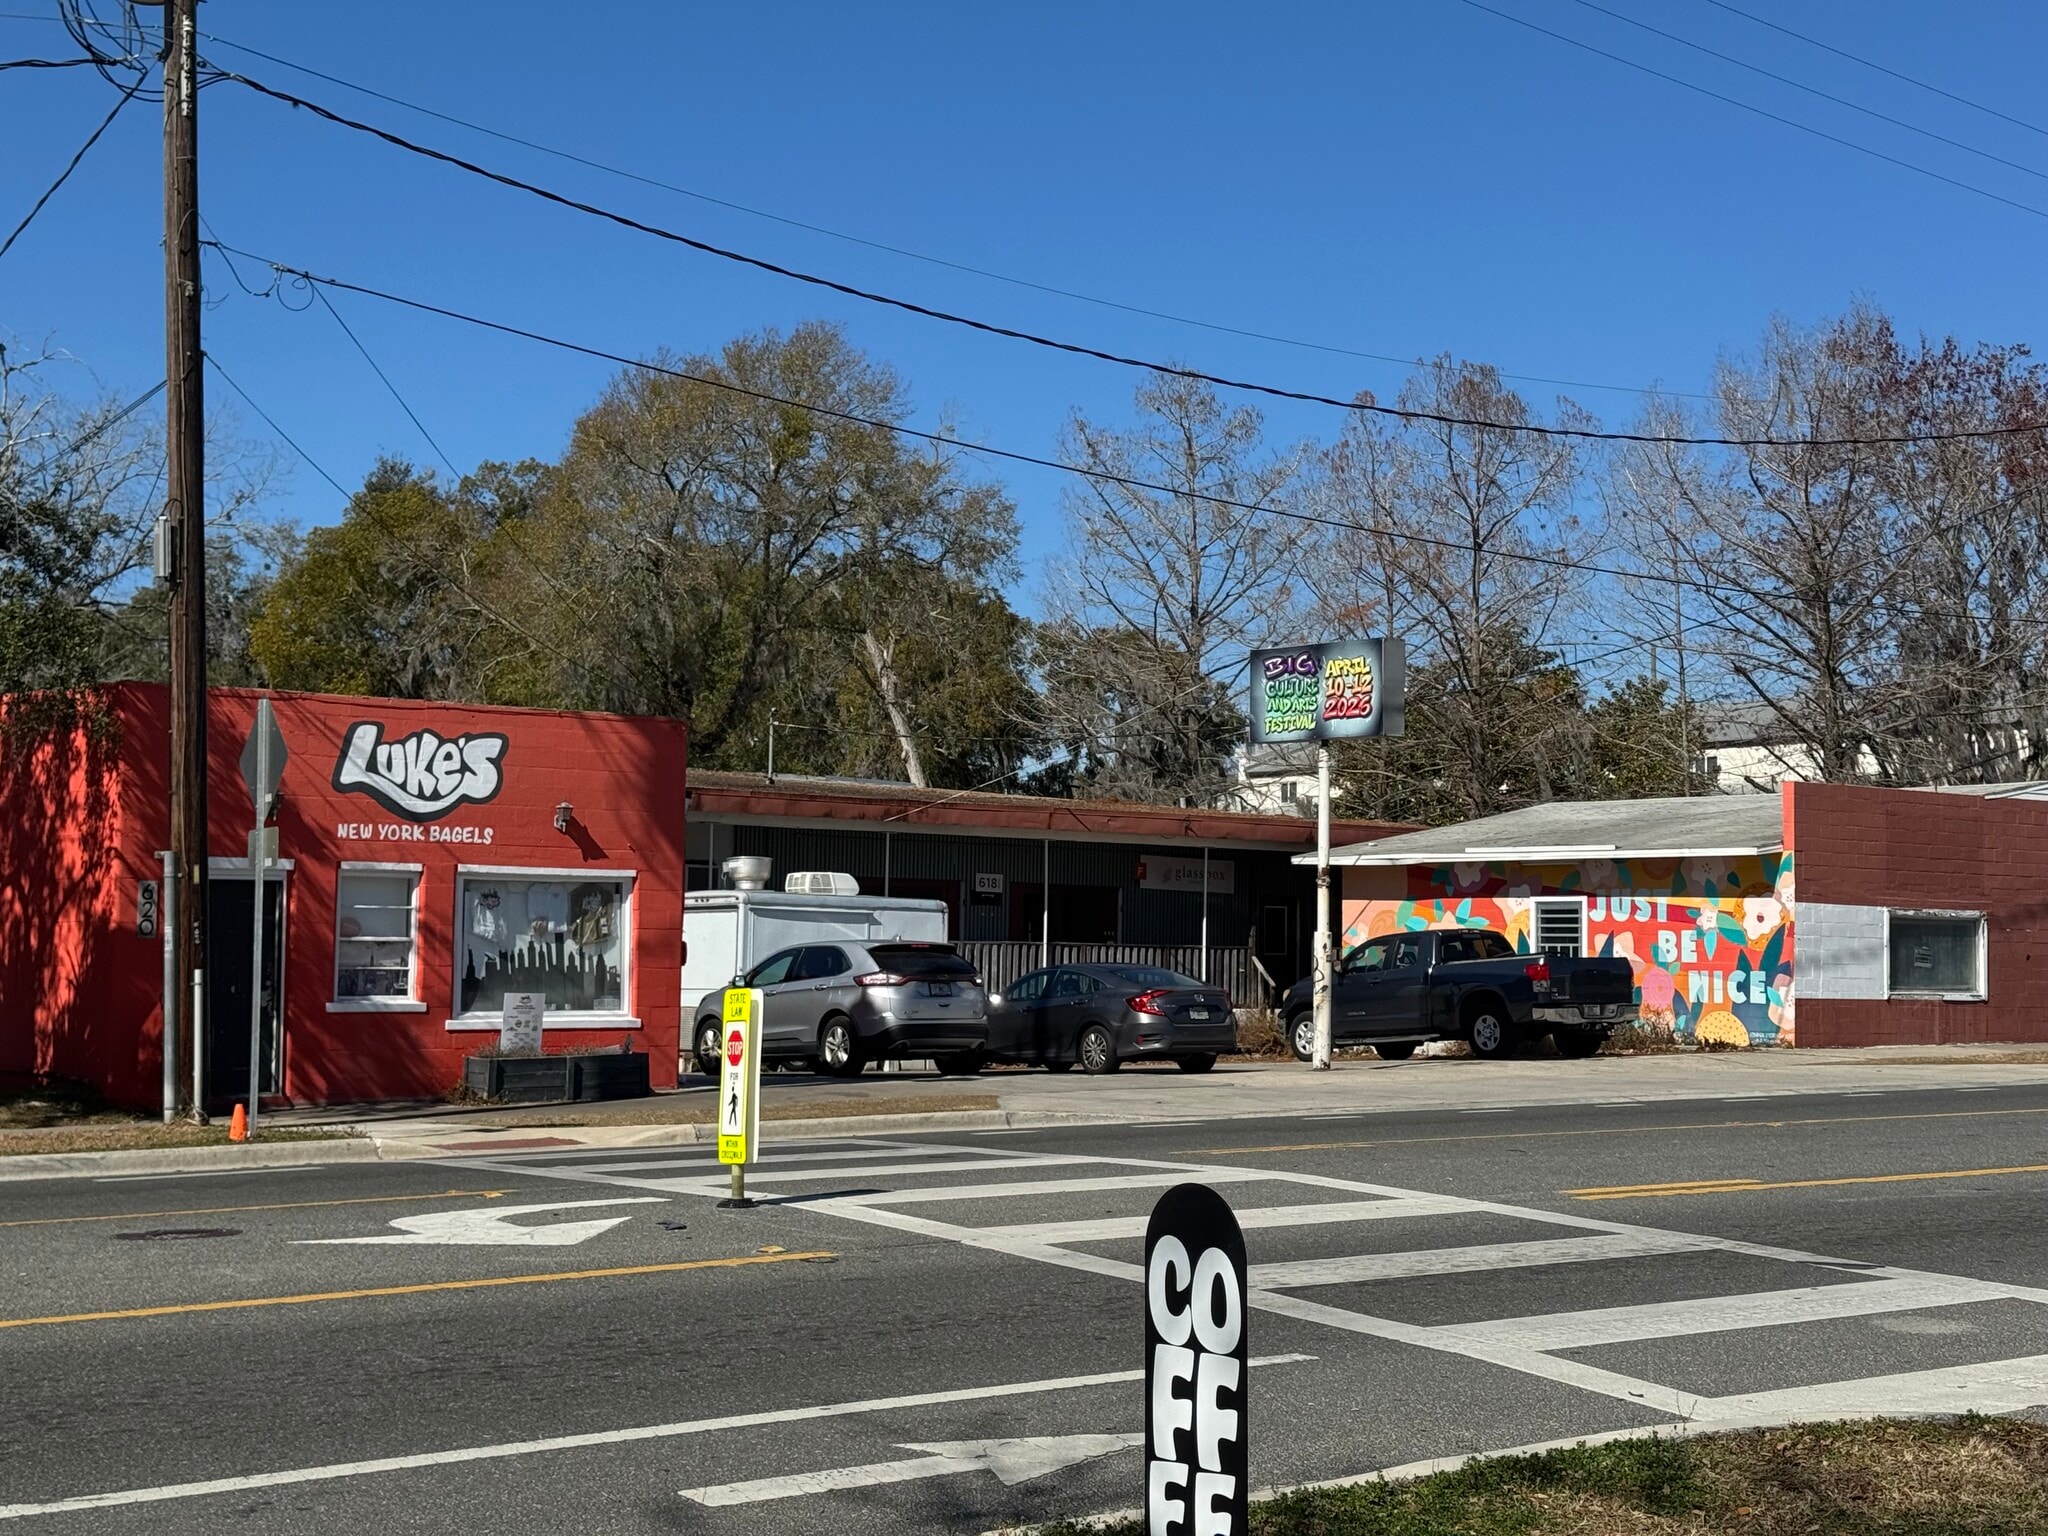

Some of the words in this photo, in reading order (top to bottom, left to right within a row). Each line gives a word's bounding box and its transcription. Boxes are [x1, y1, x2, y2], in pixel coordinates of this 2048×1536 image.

[1263, 652, 1317, 679] BIG
[1325, 657, 1371, 677] APRIL
[1265, 677, 1319, 698] CULTURE
[1326, 675, 1373, 697] 10-12
[1267, 697, 1291, 712] AND
[1291, 697, 1317, 712] ARTS
[1323, 697, 1372, 719] 2026
[1265, 715, 1316, 733] FESTIVAL
[337, 823, 372, 839] NEW
[378, 825, 425, 841] YORK
[429, 826, 494, 845] BAGELS
[979, 877, 997, 889] 618
[140, 884, 153, 935] 620
[1589, 889, 1672, 922] JUST
[1658, 930, 1698, 963] BE
[1688, 970, 1767, 1004] NICE
[729, 993, 746, 1004] STATE
[731, 1007, 742, 1017] LAW
[728, 1041, 743, 1055] STOP
